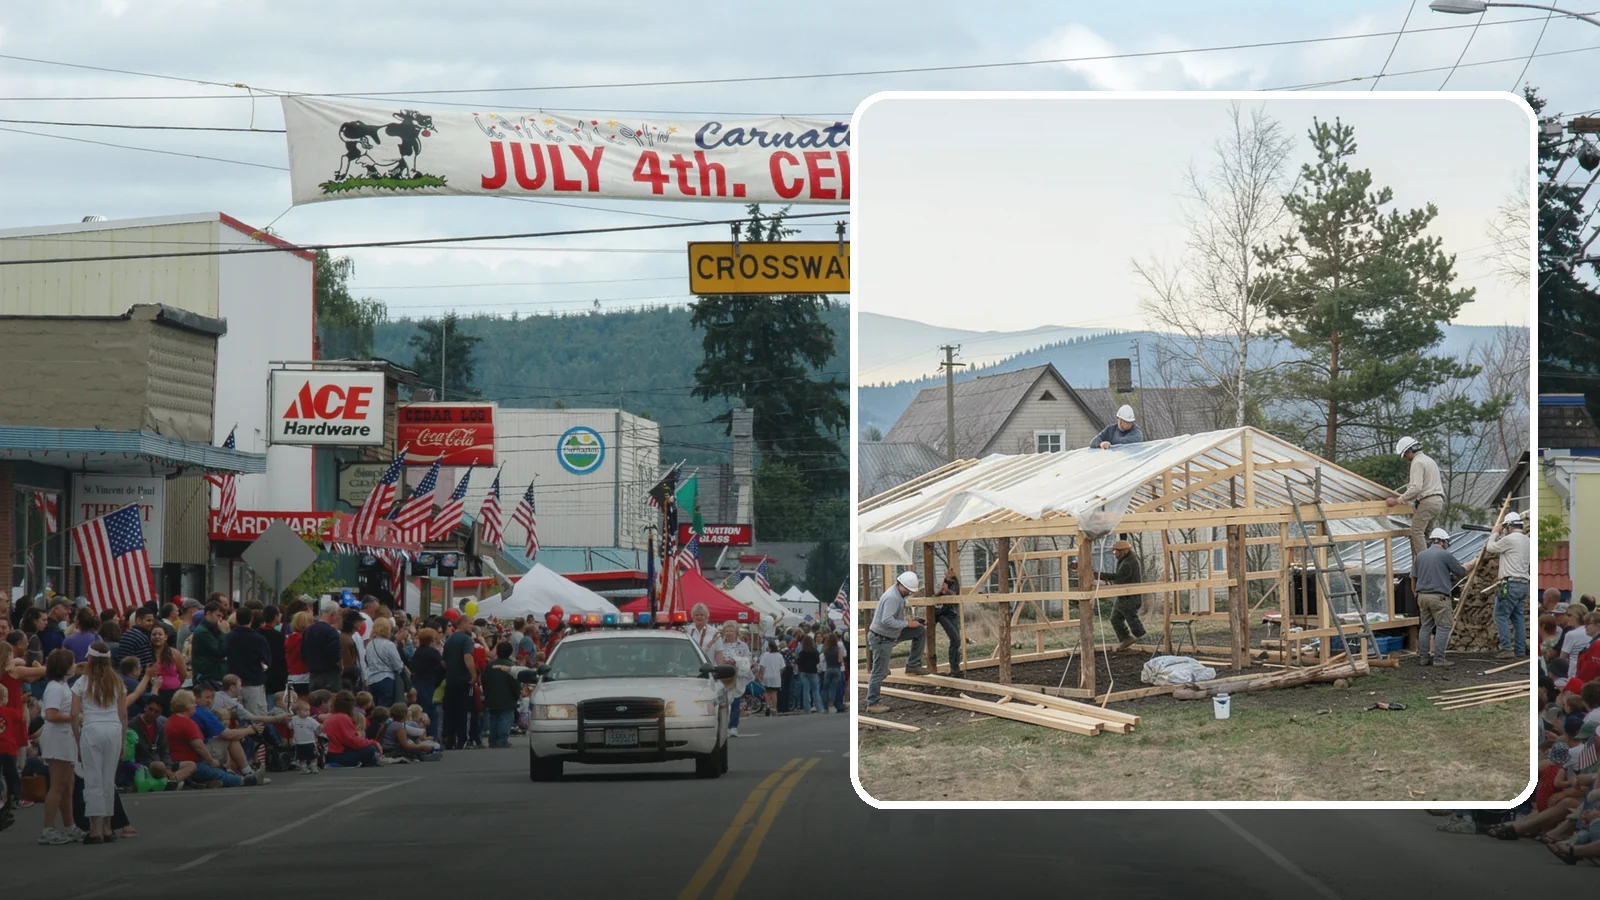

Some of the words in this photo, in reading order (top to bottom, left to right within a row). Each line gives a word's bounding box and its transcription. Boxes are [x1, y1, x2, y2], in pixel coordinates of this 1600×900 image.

[481, 141, 605, 192] JULY
[632, 150, 746, 197] 4th.
[697, 254, 850, 280] CROSSWA
[283, 380, 373, 420] ACE
[406, 409, 452, 421] CEDAR
[461, 409, 485, 421] LOG
[284, 421, 371, 436] Hardware
[416, 428, 477, 447] Coca-Cola
[353, 467, 386, 483] Simpl
[96, 485, 124, 494] Vincent
[126, 486, 135, 495] de
[137, 486, 155, 495] Paul
[81, 504, 154, 521] THT
[212, 516, 330, 535] HARDARE
[688, 527, 741, 535] CRNATION
[699, 535, 730, 543] GLASS
